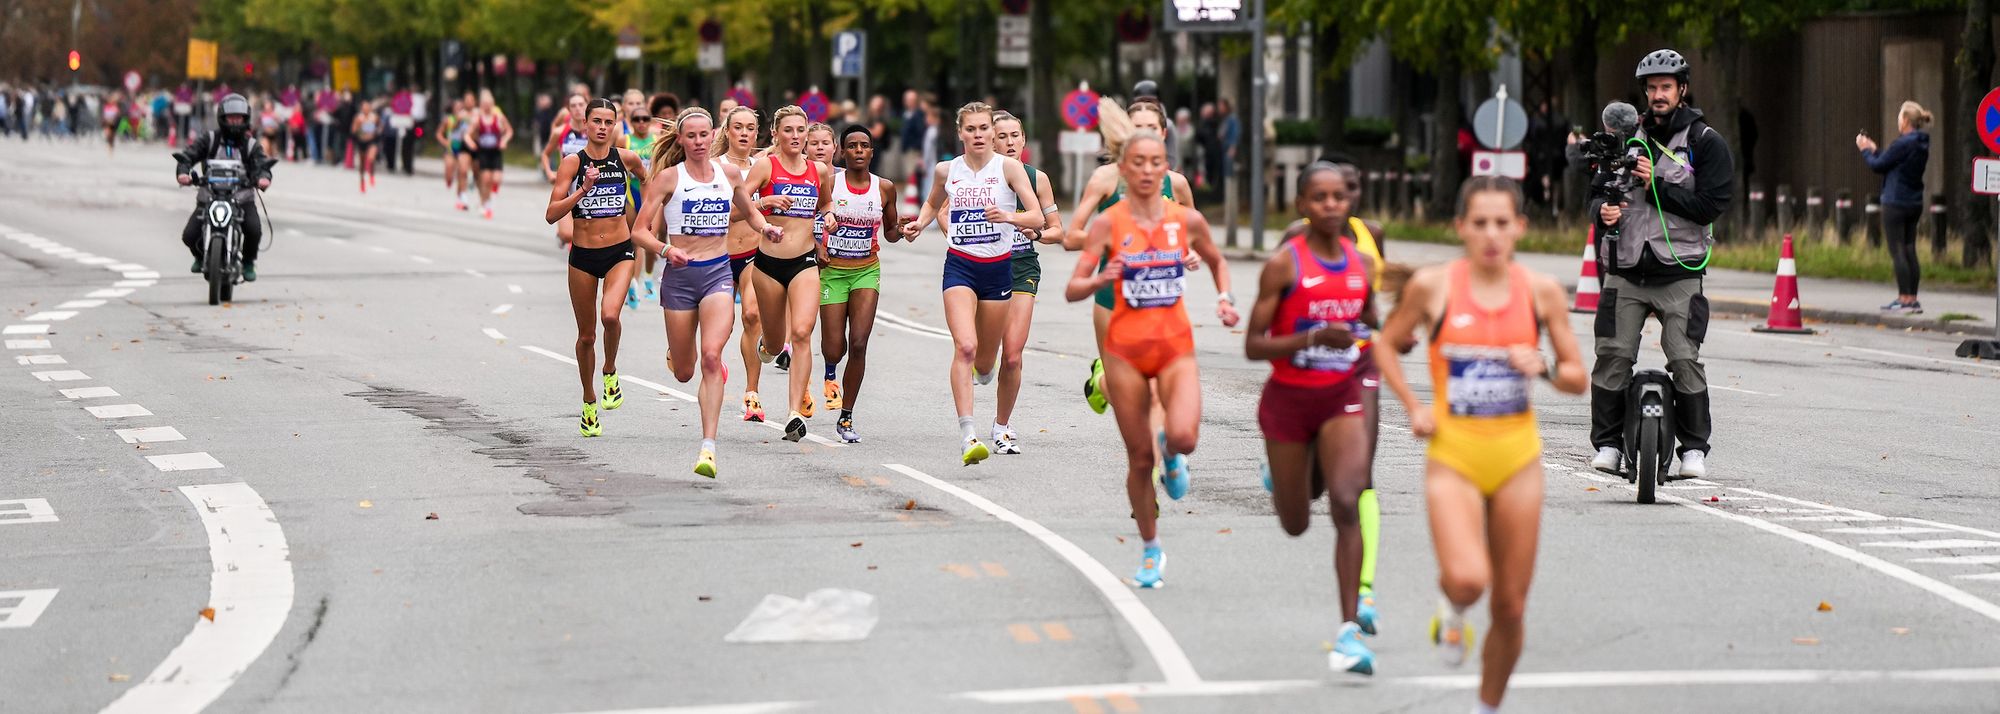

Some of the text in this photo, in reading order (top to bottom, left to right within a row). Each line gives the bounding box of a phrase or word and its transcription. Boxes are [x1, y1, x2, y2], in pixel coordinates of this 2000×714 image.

[597, 186, 617, 195] asics
[791, 186, 811, 195] asics
[956, 187, 992, 197] GREAT
[581, 196, 622, 208] GAPES
[702, 202, 724, 212] asics
[794, 197, 816, 208] INGER
[954, 197, 996, 208] BRITAIN
[683, 214, 728, 226] FRERICHS
[967, 211, 986, 221] asic
[845, 229, 867, 237] asics
[956, 222, 994, 235] KEITH
[1128, 281, 1160, 296] VAN
